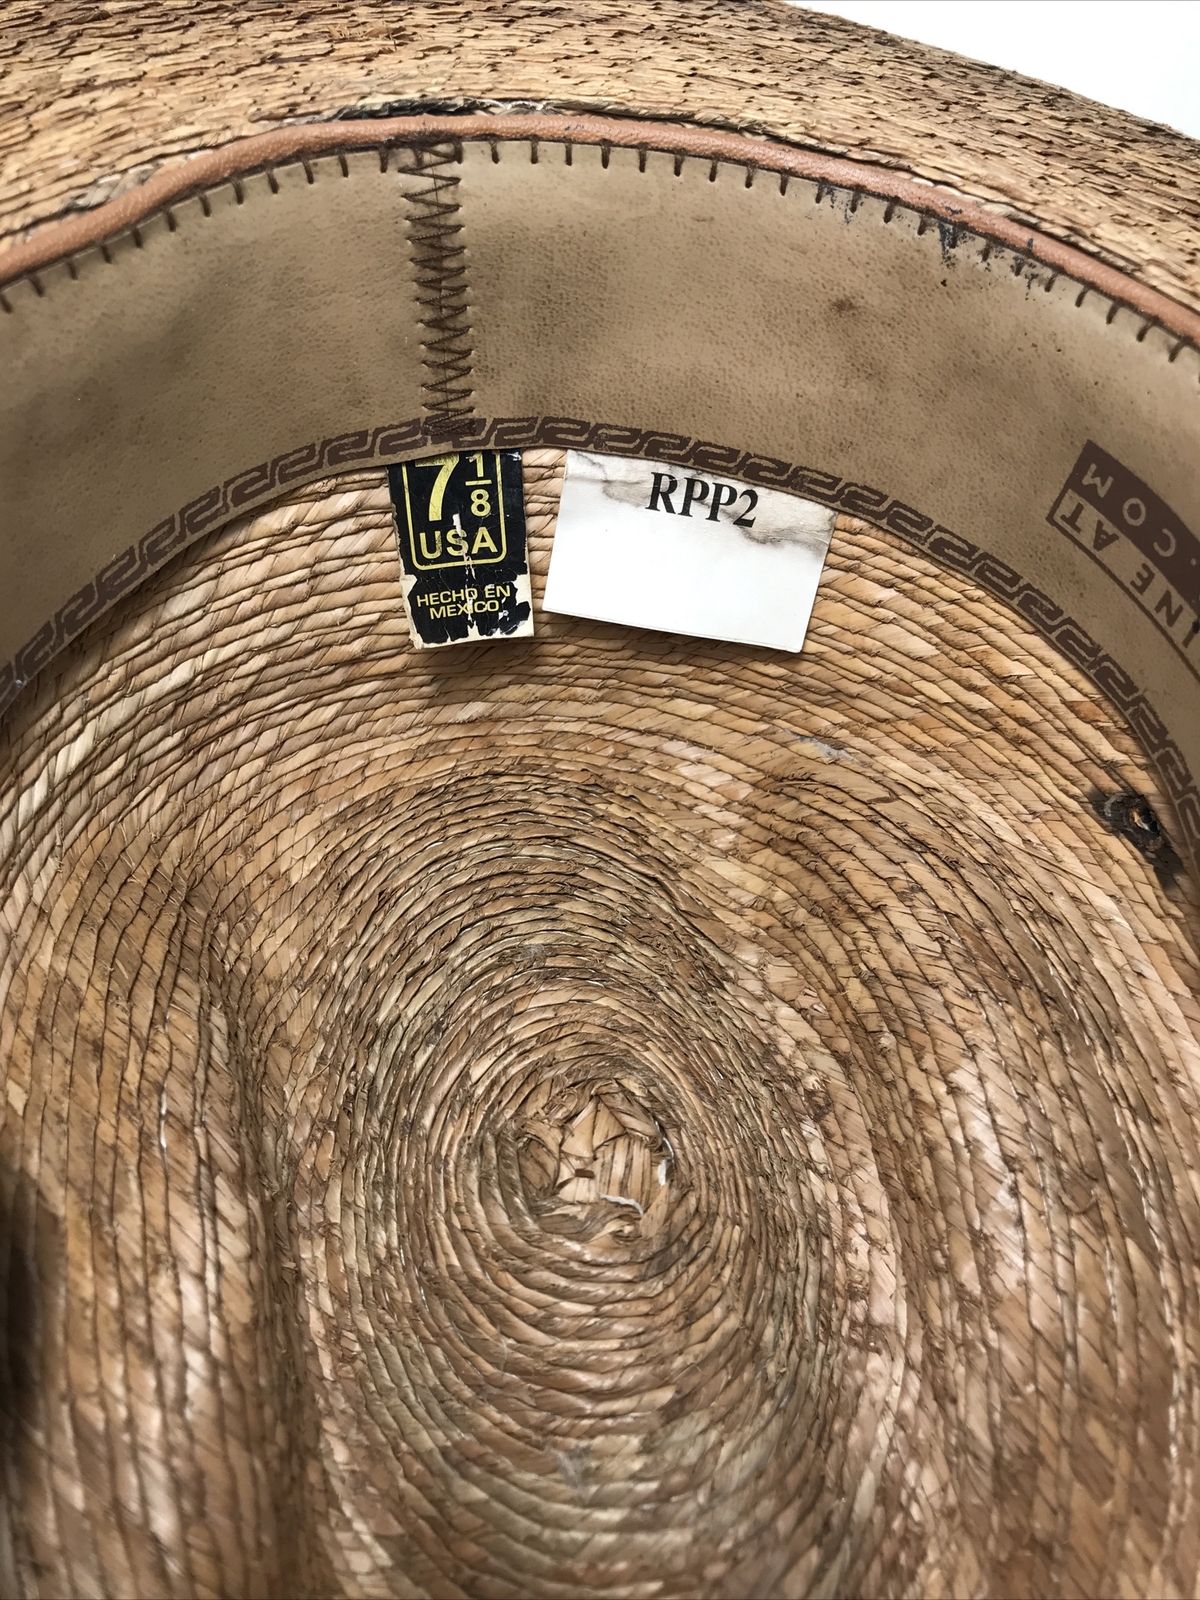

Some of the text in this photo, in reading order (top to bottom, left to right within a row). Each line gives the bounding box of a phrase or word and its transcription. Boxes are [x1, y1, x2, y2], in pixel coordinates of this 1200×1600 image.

[415, 453, 460, 521] 7
[645, 471, 759, 528] RPP2
[419, 526, 498, 559] USA
[1060, 502, 1119, 551] AT
[416, 584, 511, 607] HECHO EN
[429, 600, 499, 620] MEXICO
